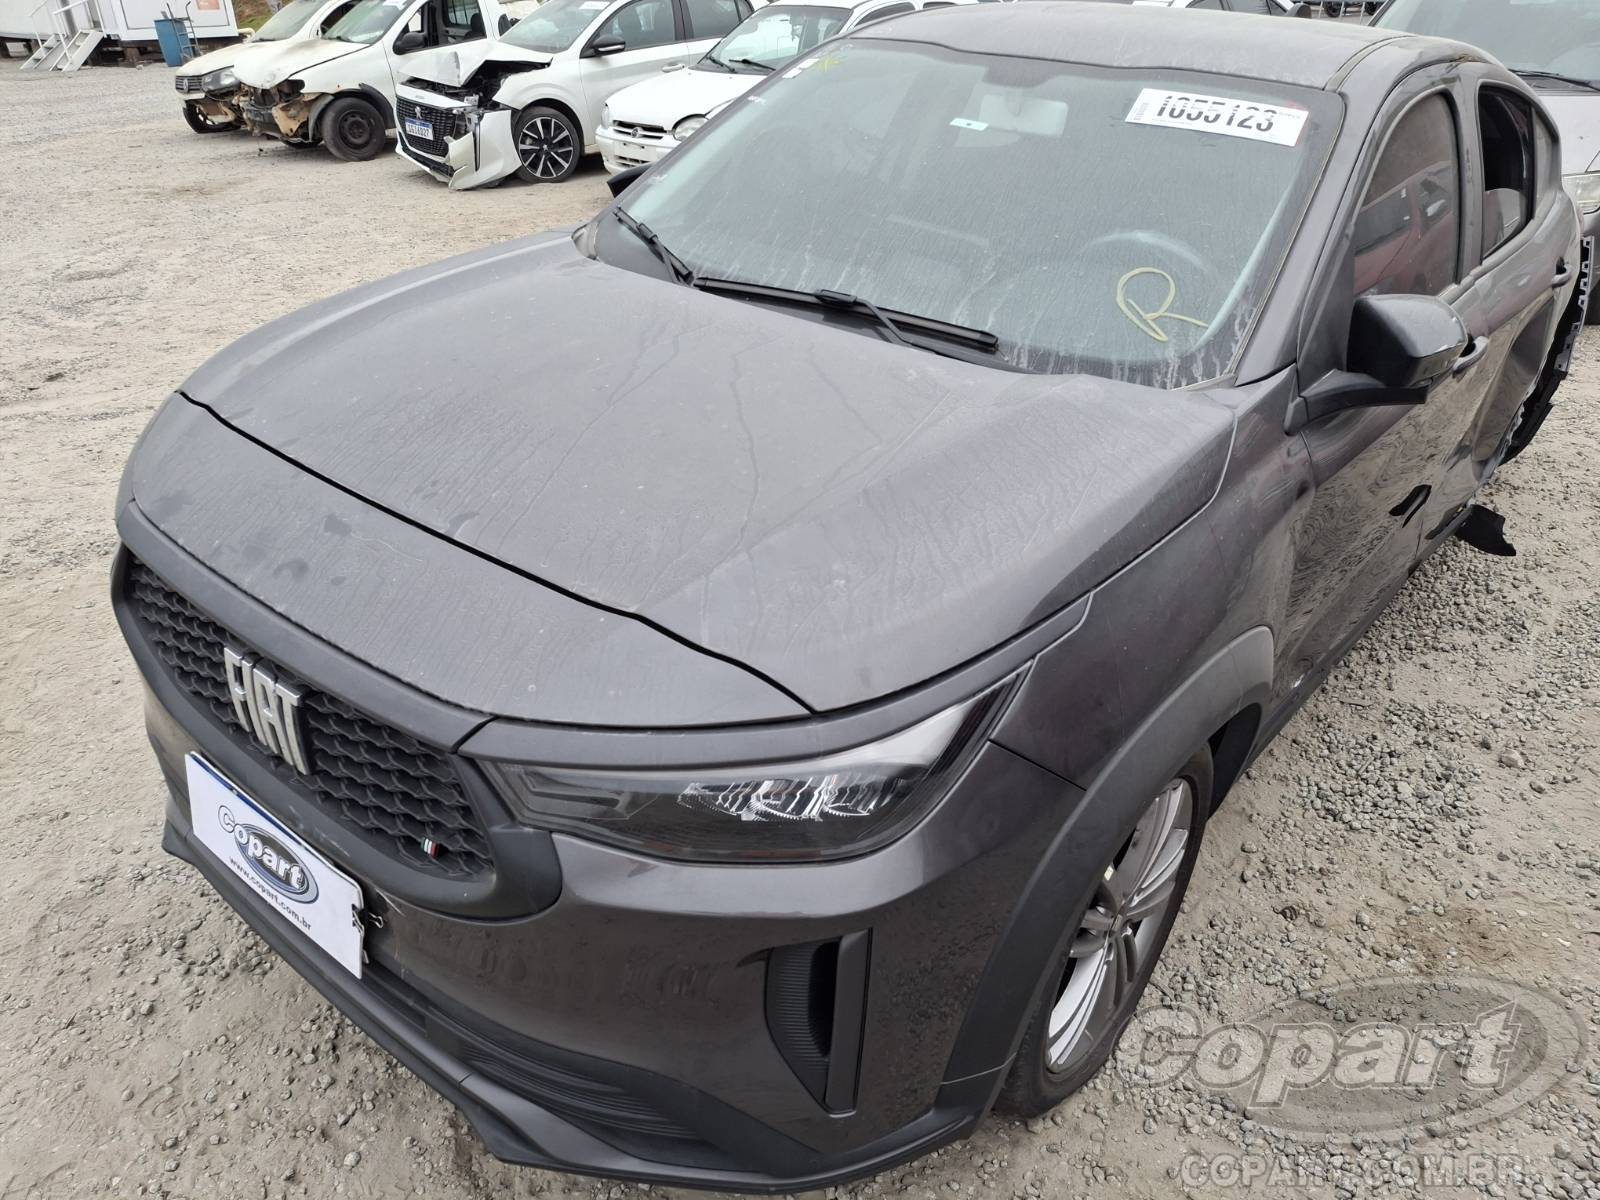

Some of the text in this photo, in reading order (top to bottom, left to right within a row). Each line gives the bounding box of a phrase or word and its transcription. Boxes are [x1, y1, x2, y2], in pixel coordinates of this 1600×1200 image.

[1157, 95, 1277, 132] 1055123
[223, 647, 308, 775] FIAT
[217, 804, 305, 890] Copart
[229, 856, 312, 930] www.copart.com.br
